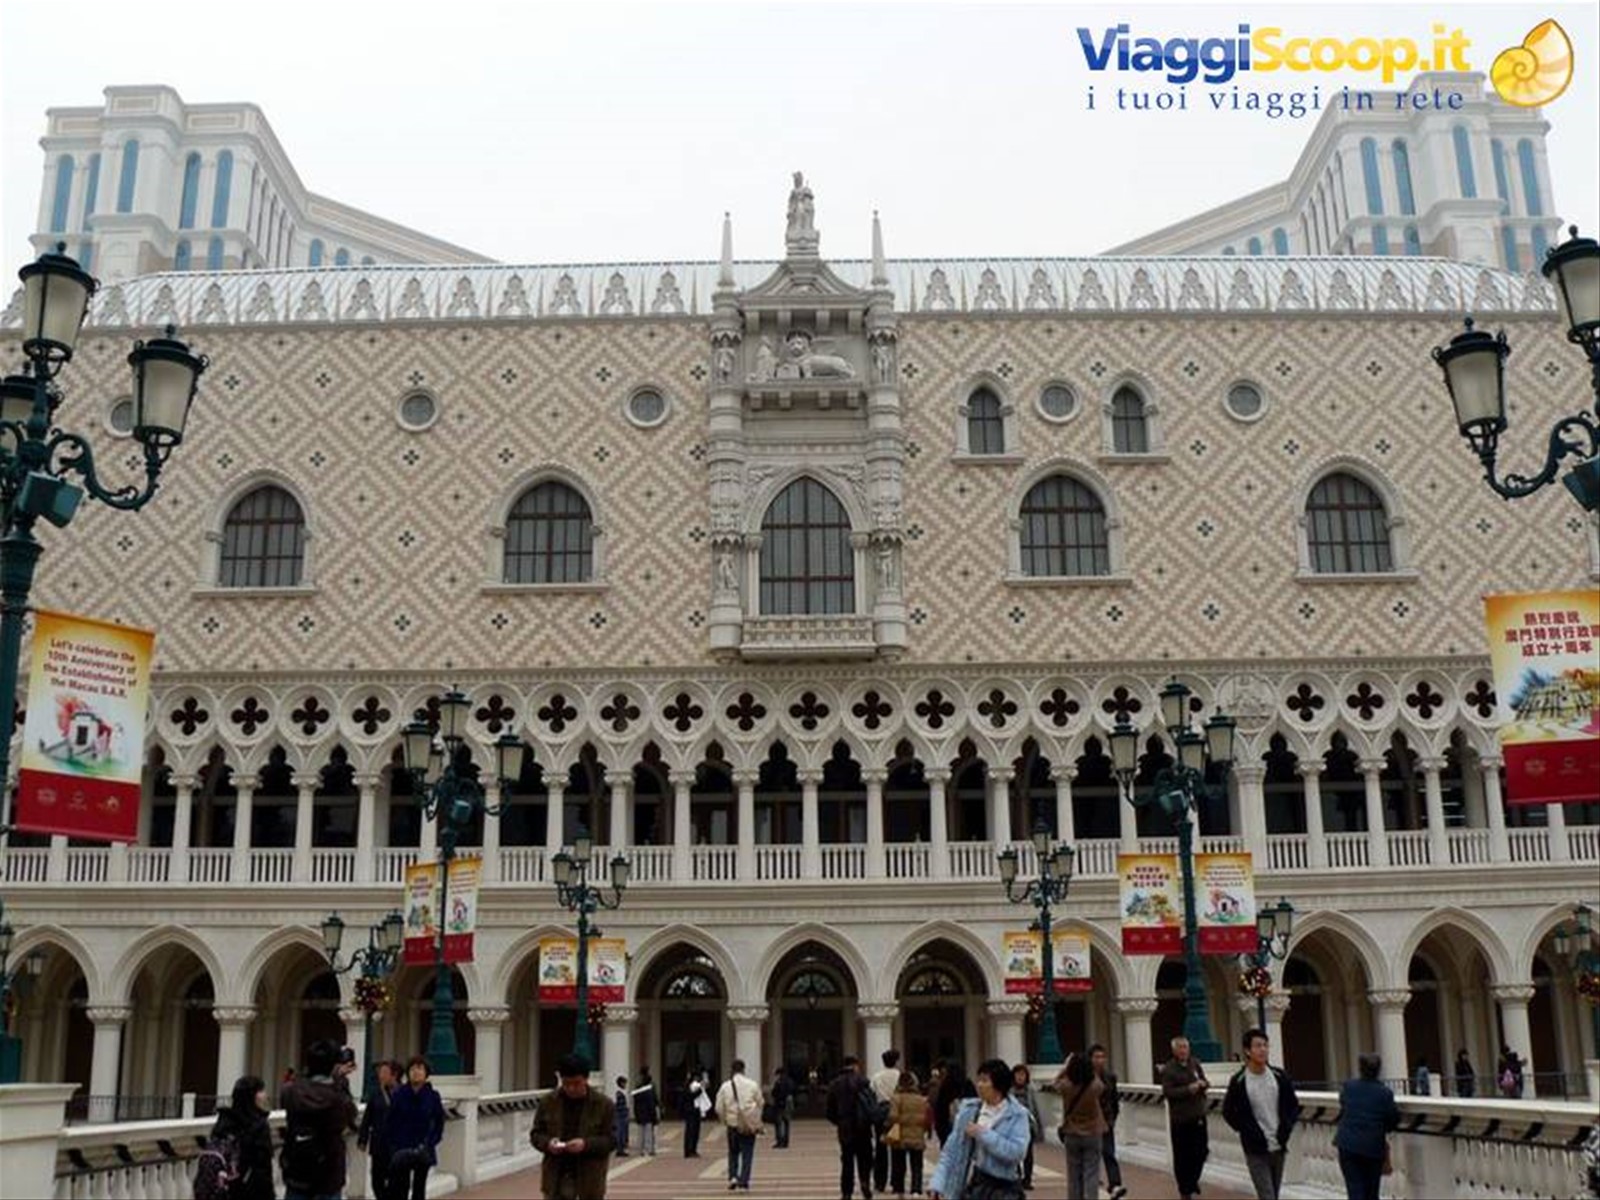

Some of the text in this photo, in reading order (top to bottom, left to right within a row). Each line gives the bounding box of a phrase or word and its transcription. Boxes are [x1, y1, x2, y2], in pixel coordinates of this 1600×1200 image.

[51, 638, 135, 662] Let's celebrate the
[48, 650, 137, 675] 10th Anniversary of
[43, 662, 138, 688] the Establishment of
[51, 677, 128, 699] the Macau S.A.R.
